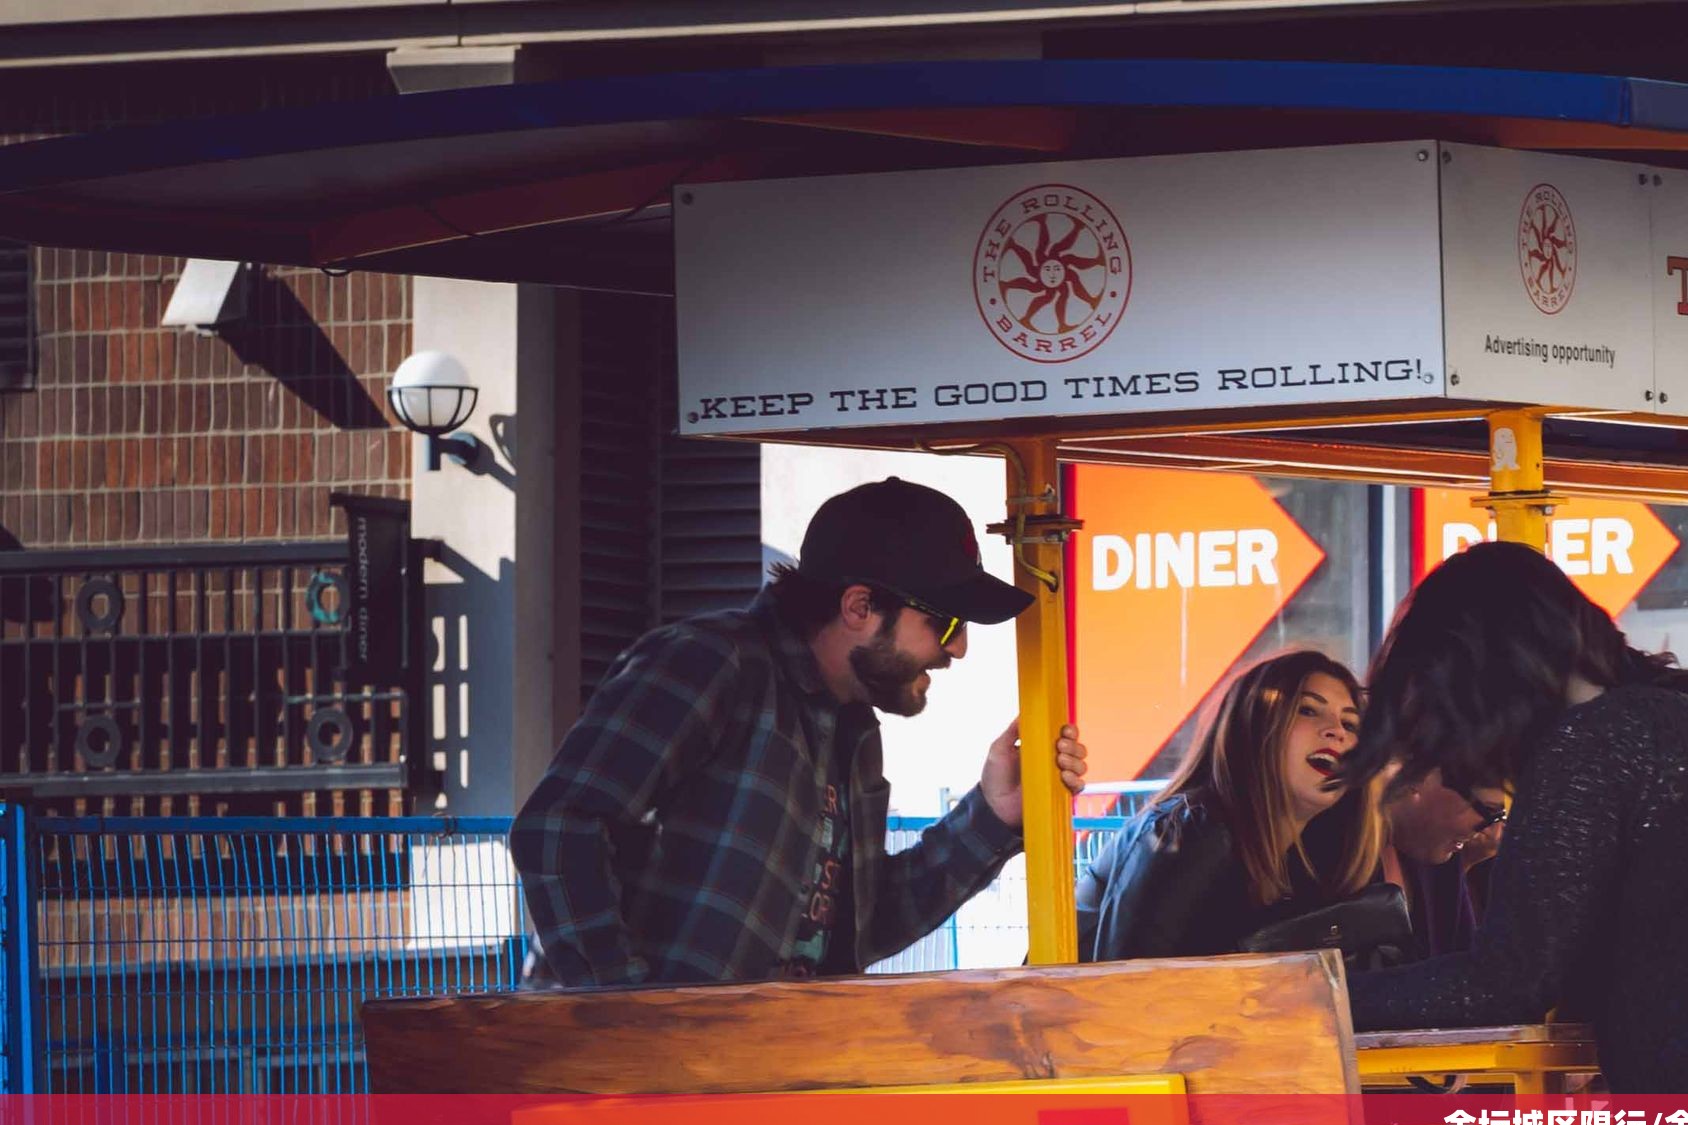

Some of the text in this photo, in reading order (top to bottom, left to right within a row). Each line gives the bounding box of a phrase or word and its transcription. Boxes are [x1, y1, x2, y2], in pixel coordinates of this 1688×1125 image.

[983, 194, 1122, 353] THE ROLLING BARREL
[1484, 334, 1616, 369] Advertising opportunity
[700, 358, 1422, 419] KEEP THE GOOD TIMES ROLLING!
[1091, 528, 1279, 592] DINER
